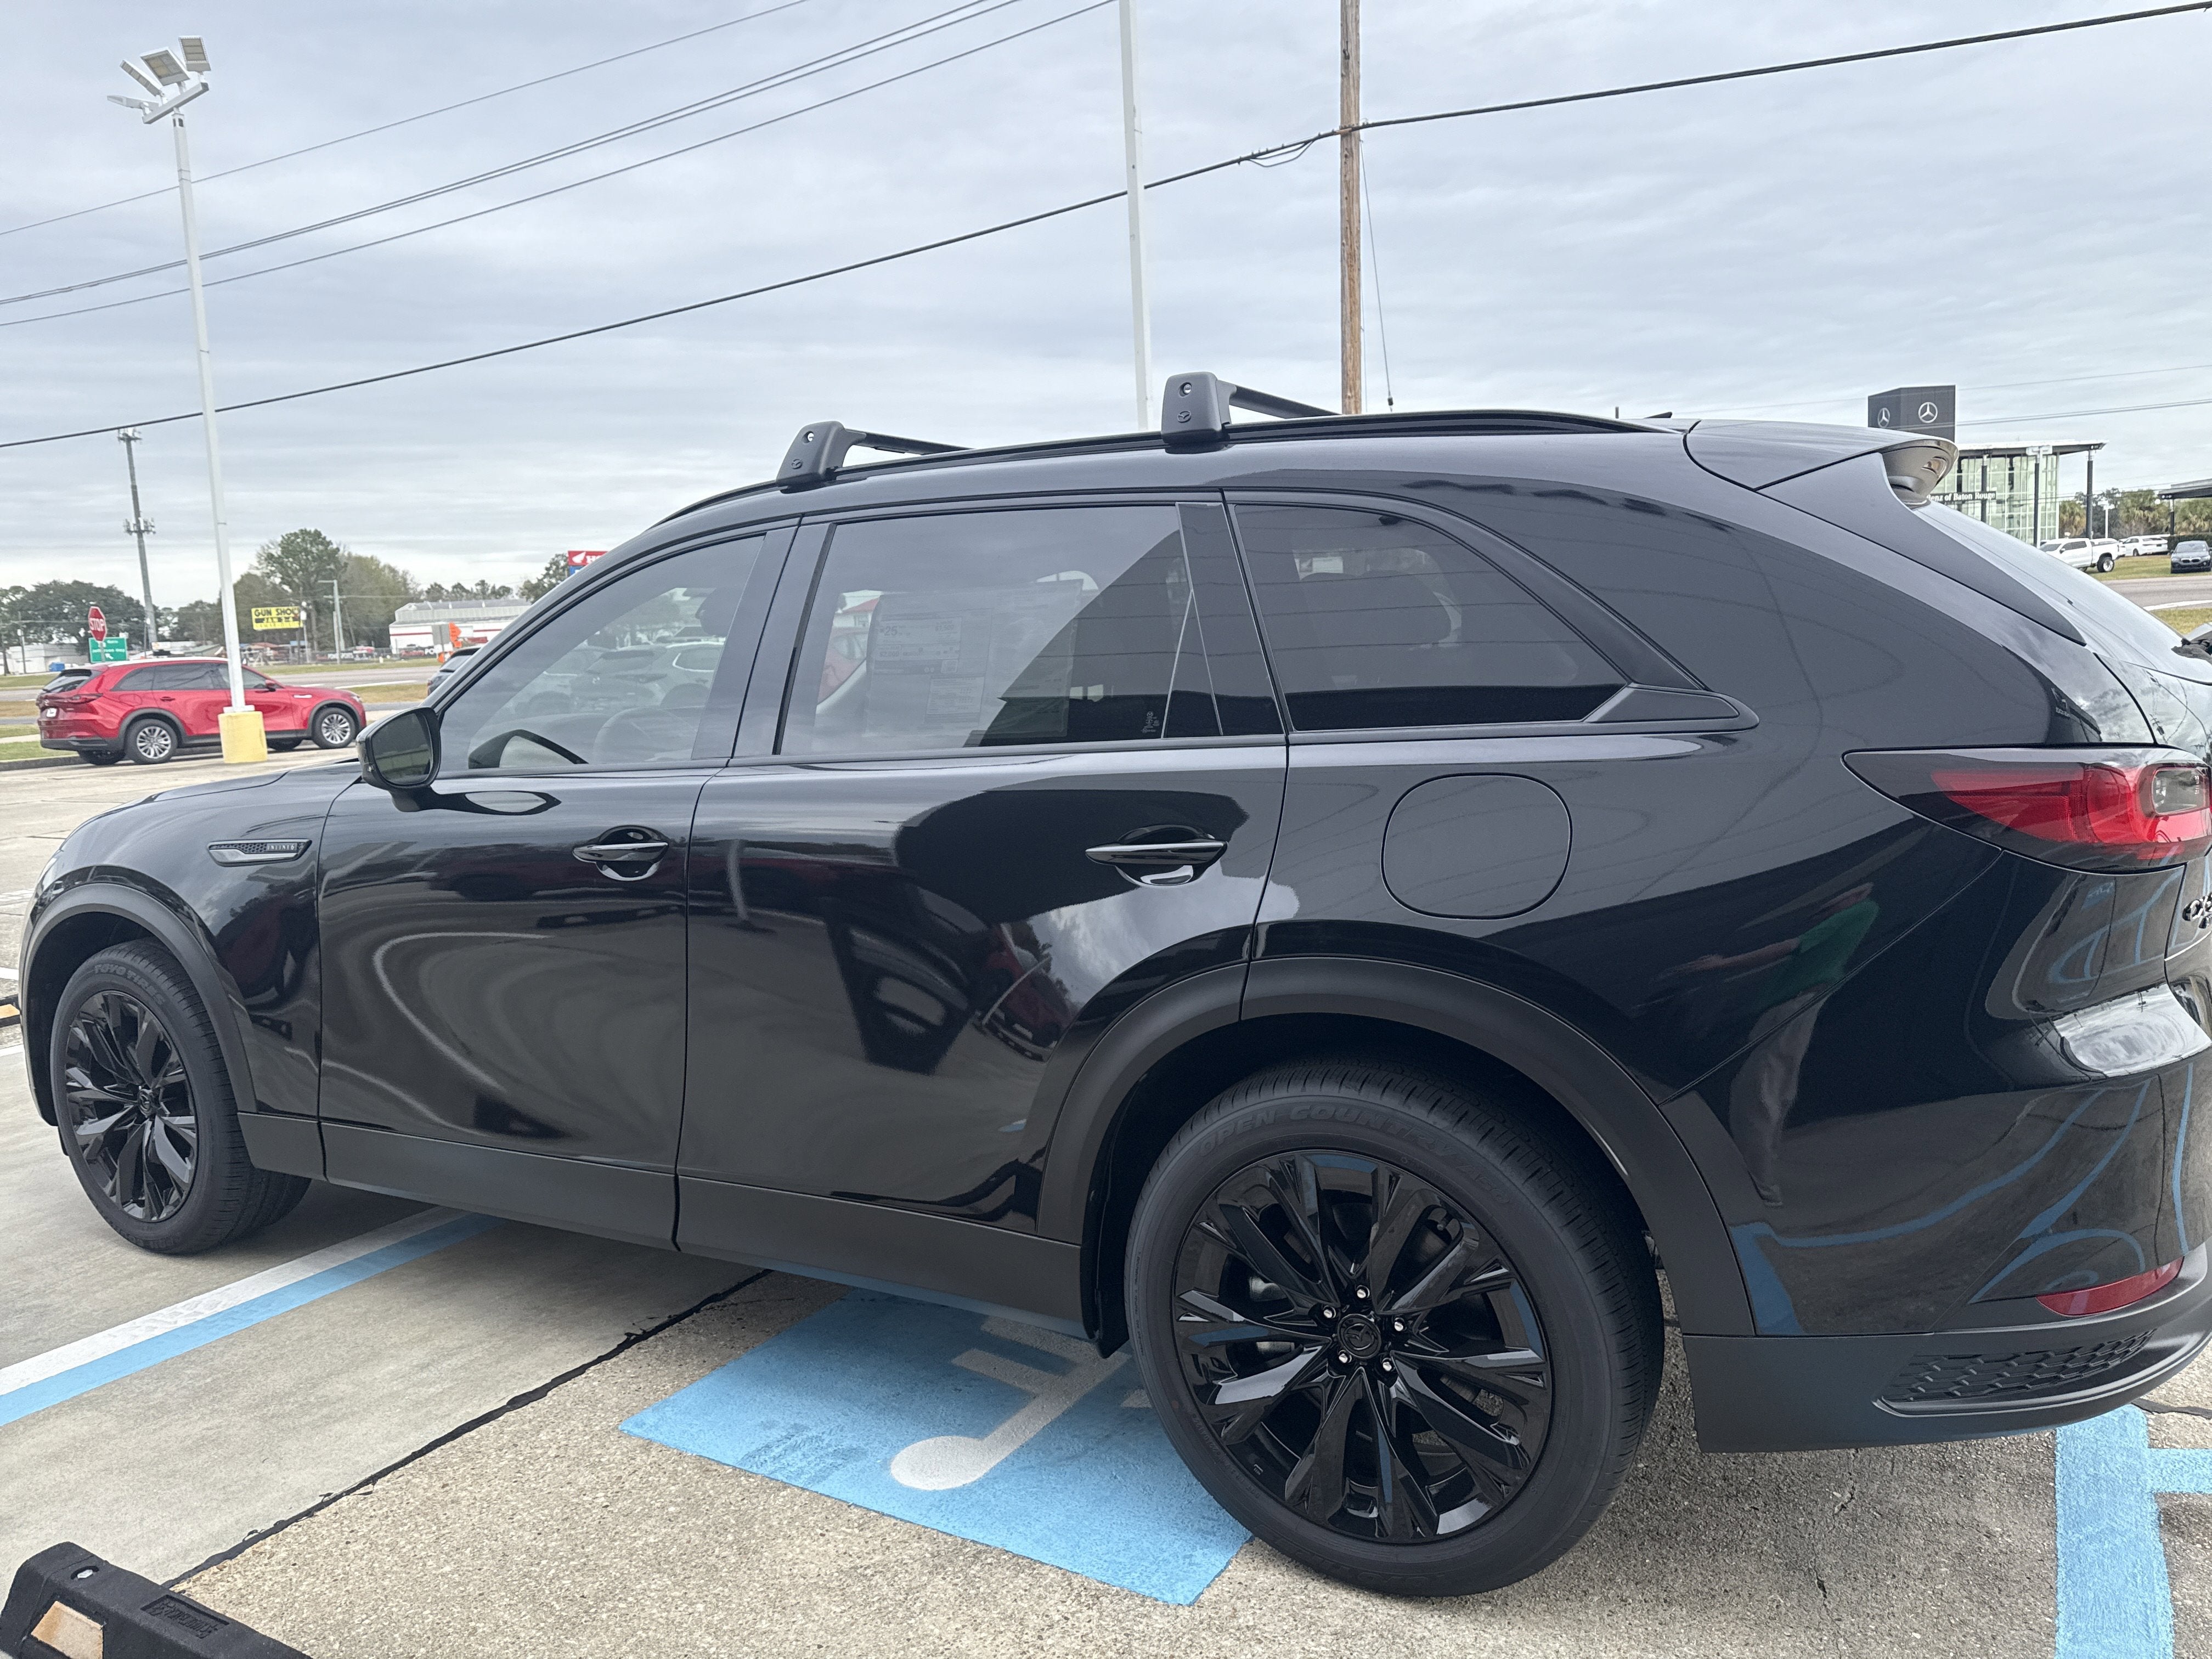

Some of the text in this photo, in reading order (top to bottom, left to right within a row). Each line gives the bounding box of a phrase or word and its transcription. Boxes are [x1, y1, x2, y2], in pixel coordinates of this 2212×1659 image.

[1974, 492, 1995, 500] Rouge
[254, 609, 272, 617] GUN
[89, 617, 105, 631] STOP
[884, 625, 898, 636] 25
[94, 963, 165, 1005] TOYO TIRES
[1198, 1108, 1278, 1157] OPEN
[1289, 1103, 1456, 1157] COUNTRY
